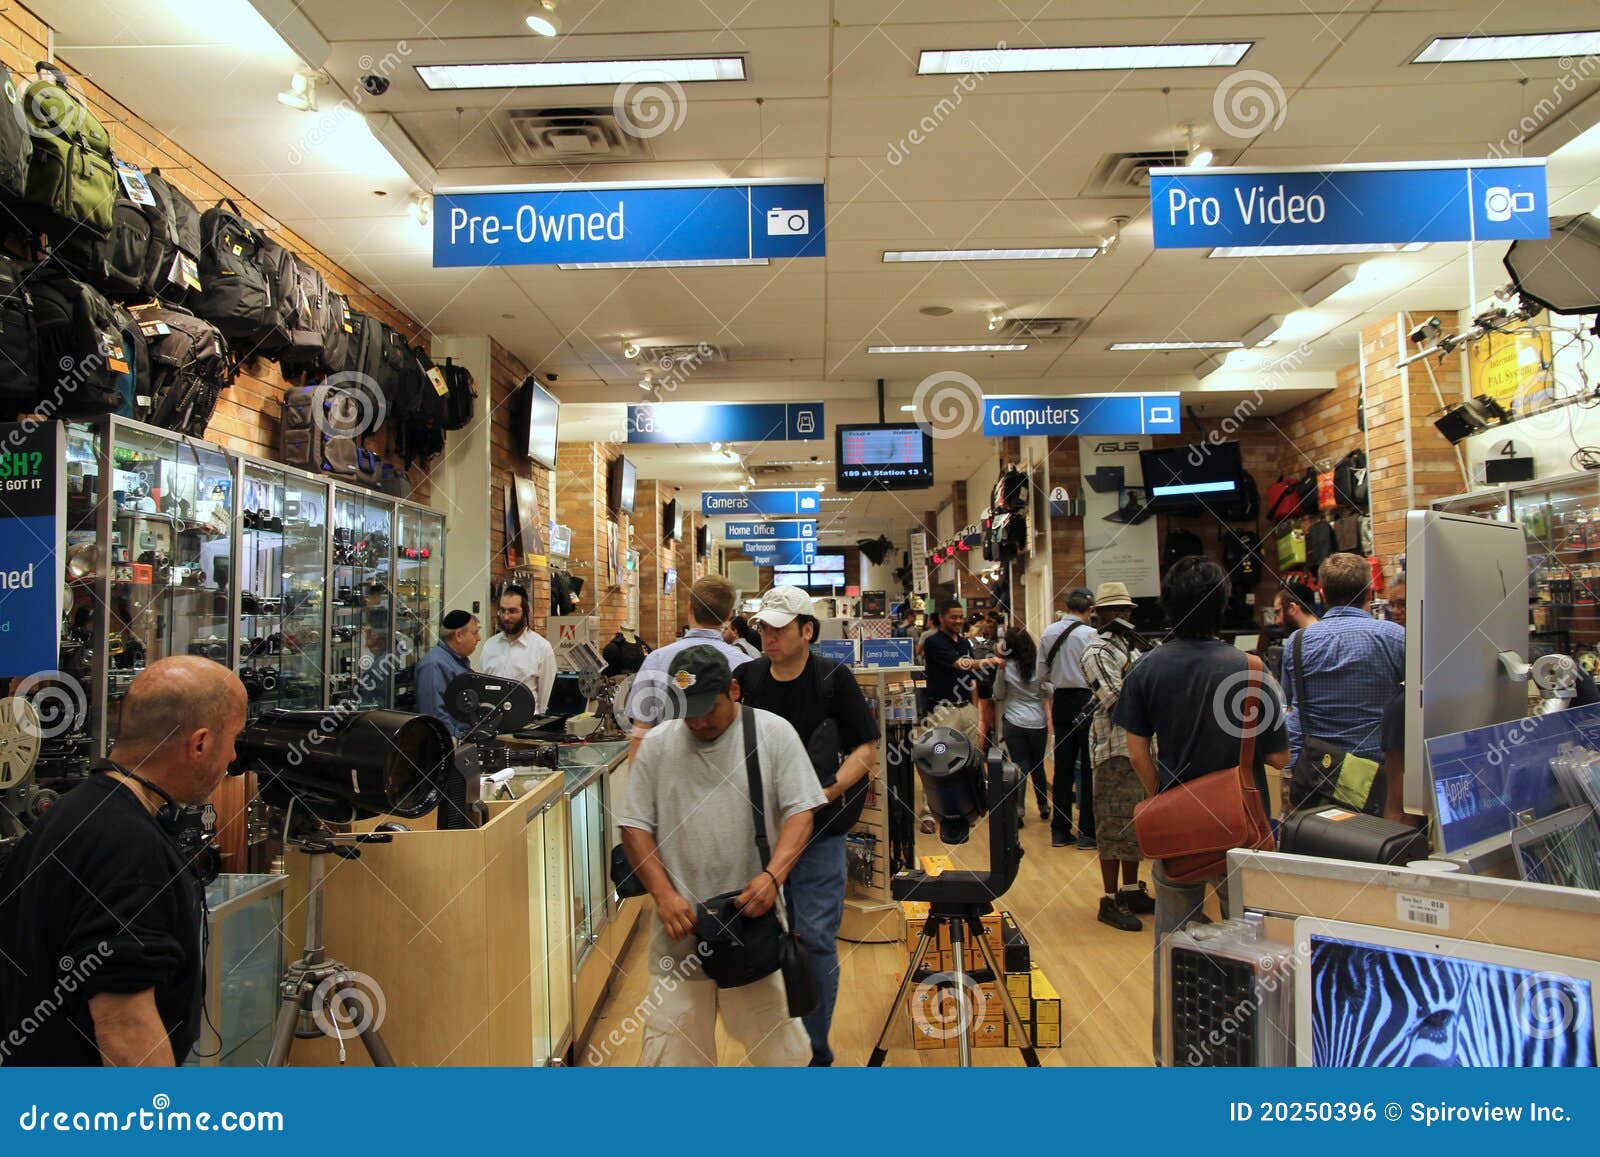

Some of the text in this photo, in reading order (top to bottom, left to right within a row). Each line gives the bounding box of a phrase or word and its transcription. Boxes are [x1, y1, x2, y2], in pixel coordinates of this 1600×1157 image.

[1169, 185, 1325, 226] Pro Video
[450, 201, 624, 245] Pre-Owned
[990, 406, 1080, 430] Computers
[1094, 442, 1140, 453] ASUS
[1501, 440, 1517, 458] 4
[873, 469, 906, 478] Station
[908, 468, 919, 476] 13
[6, 479, 28, 491] GOT
[31, 478, 43, 490] IT
[1055, 488, 1063, 501] 8
[706, 495, 749, 510] Cameras
[728, 524, 775, 536] Home Office
[745, 543, 776, 553] Darkroom
[883, 649, 899, 658] Straps
[1445, 777, 1470, 809] Apple
